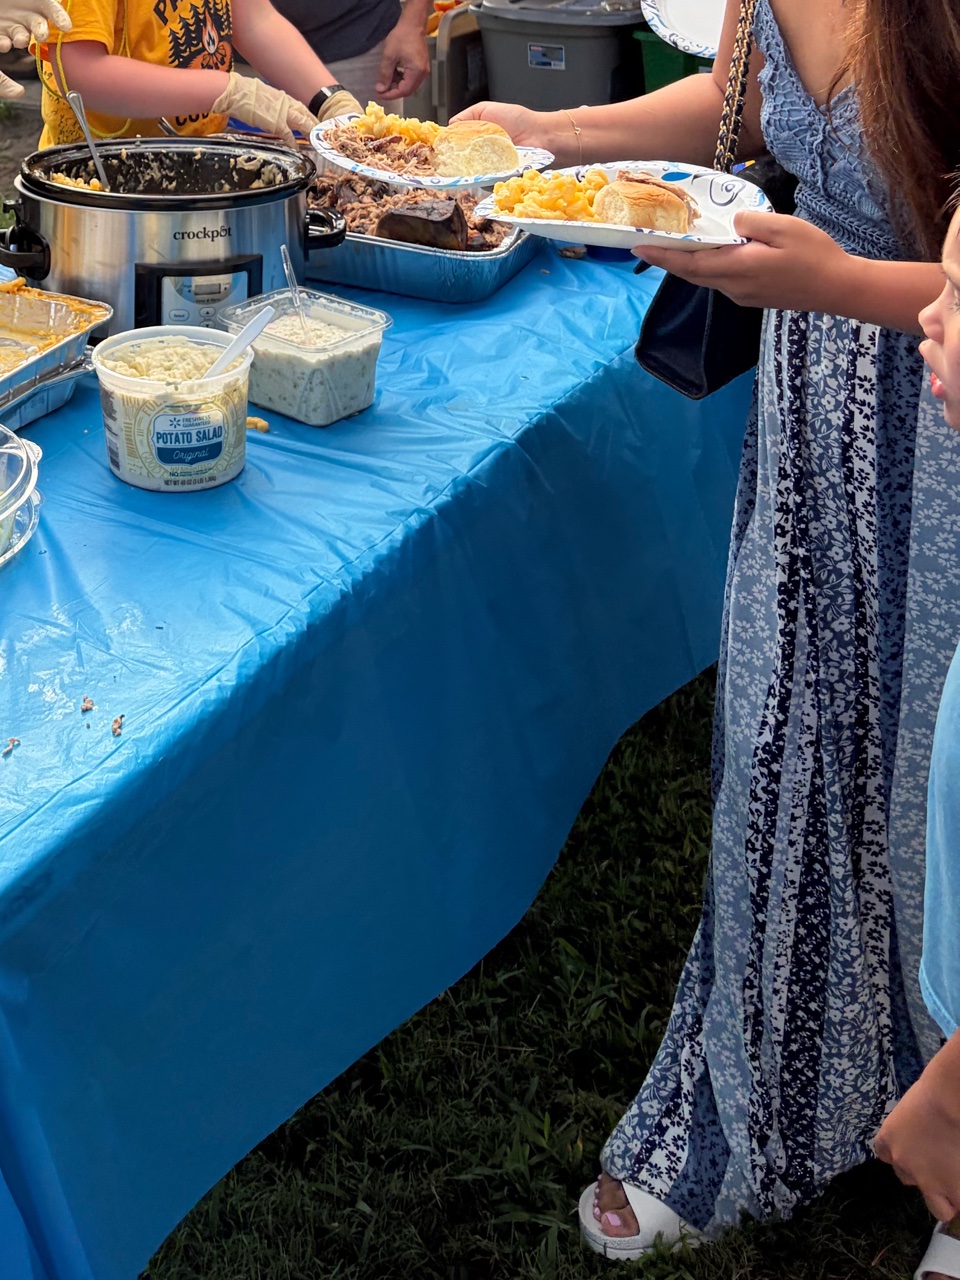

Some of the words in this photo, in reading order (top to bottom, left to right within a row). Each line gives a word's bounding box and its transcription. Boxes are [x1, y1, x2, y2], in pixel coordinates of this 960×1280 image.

[173, 225, 232, 242] crockpot
[156, 431, 192, 445] POTATO
[196, 426, 222, 443] SALAD
[173, 447, 209, 462] Original
